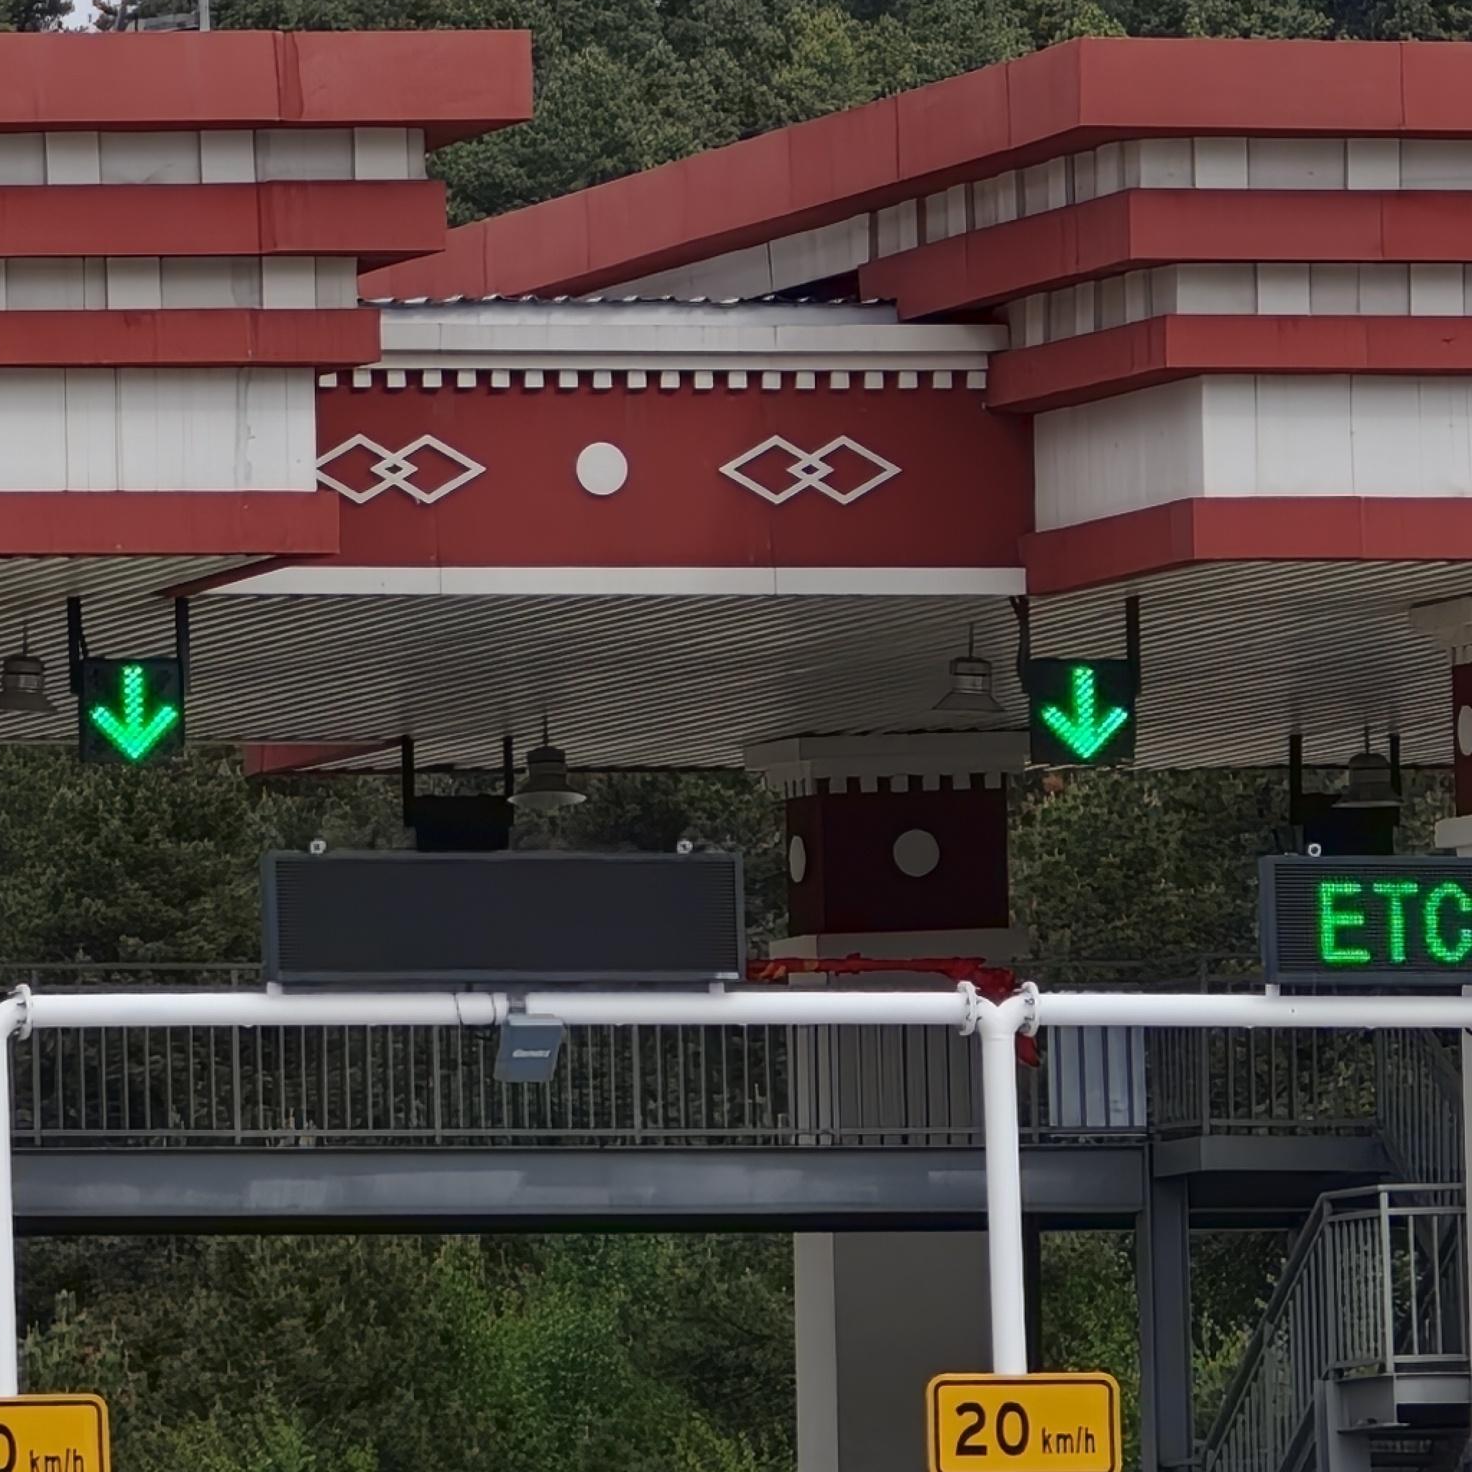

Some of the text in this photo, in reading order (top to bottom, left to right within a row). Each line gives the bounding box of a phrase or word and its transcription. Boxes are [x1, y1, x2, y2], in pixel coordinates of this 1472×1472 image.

[1318, 881, 1472, 965] ETC
[955, 1402, 1097, 1457] 20 km/h
